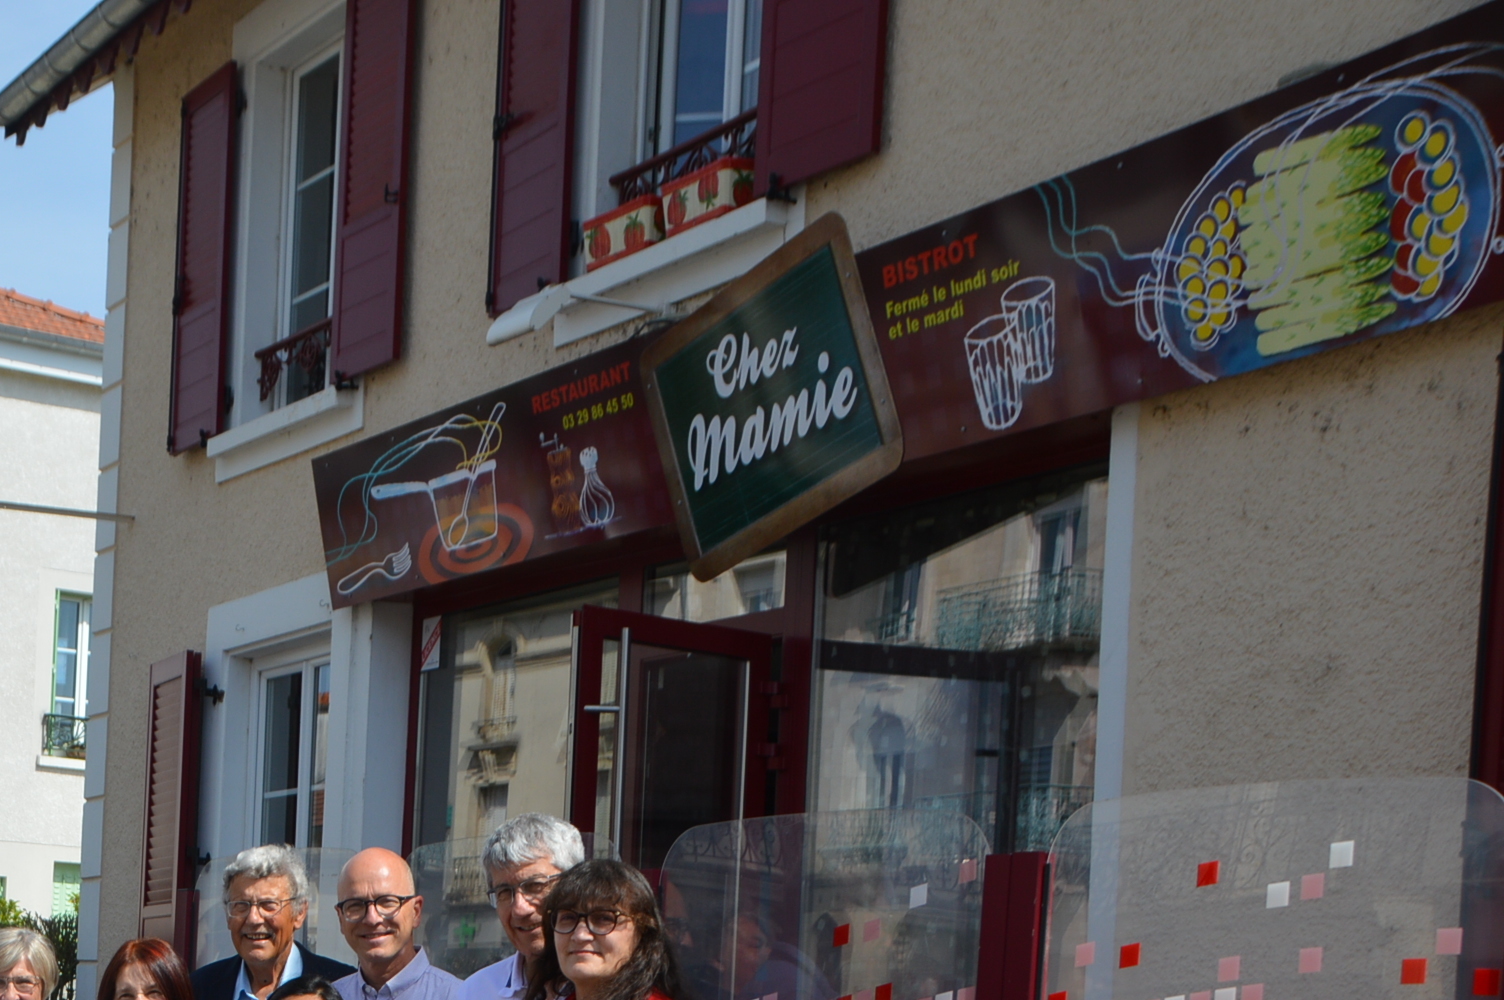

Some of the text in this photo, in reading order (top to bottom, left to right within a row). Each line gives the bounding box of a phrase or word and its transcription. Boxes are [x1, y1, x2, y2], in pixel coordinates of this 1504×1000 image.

[882, 232, 979, 289] BISTROT
[885, 259, 1020, 319] Fermé le lundi soir
[888, 299, 964, 340] et le mardi
[531, 362, 631, 414] RESTAURANT
[706, 326, 799, 398] Chez
[562, 392, 635, 430] 03 29 86 45 50
[687, 351, 858, 492] Mamie
